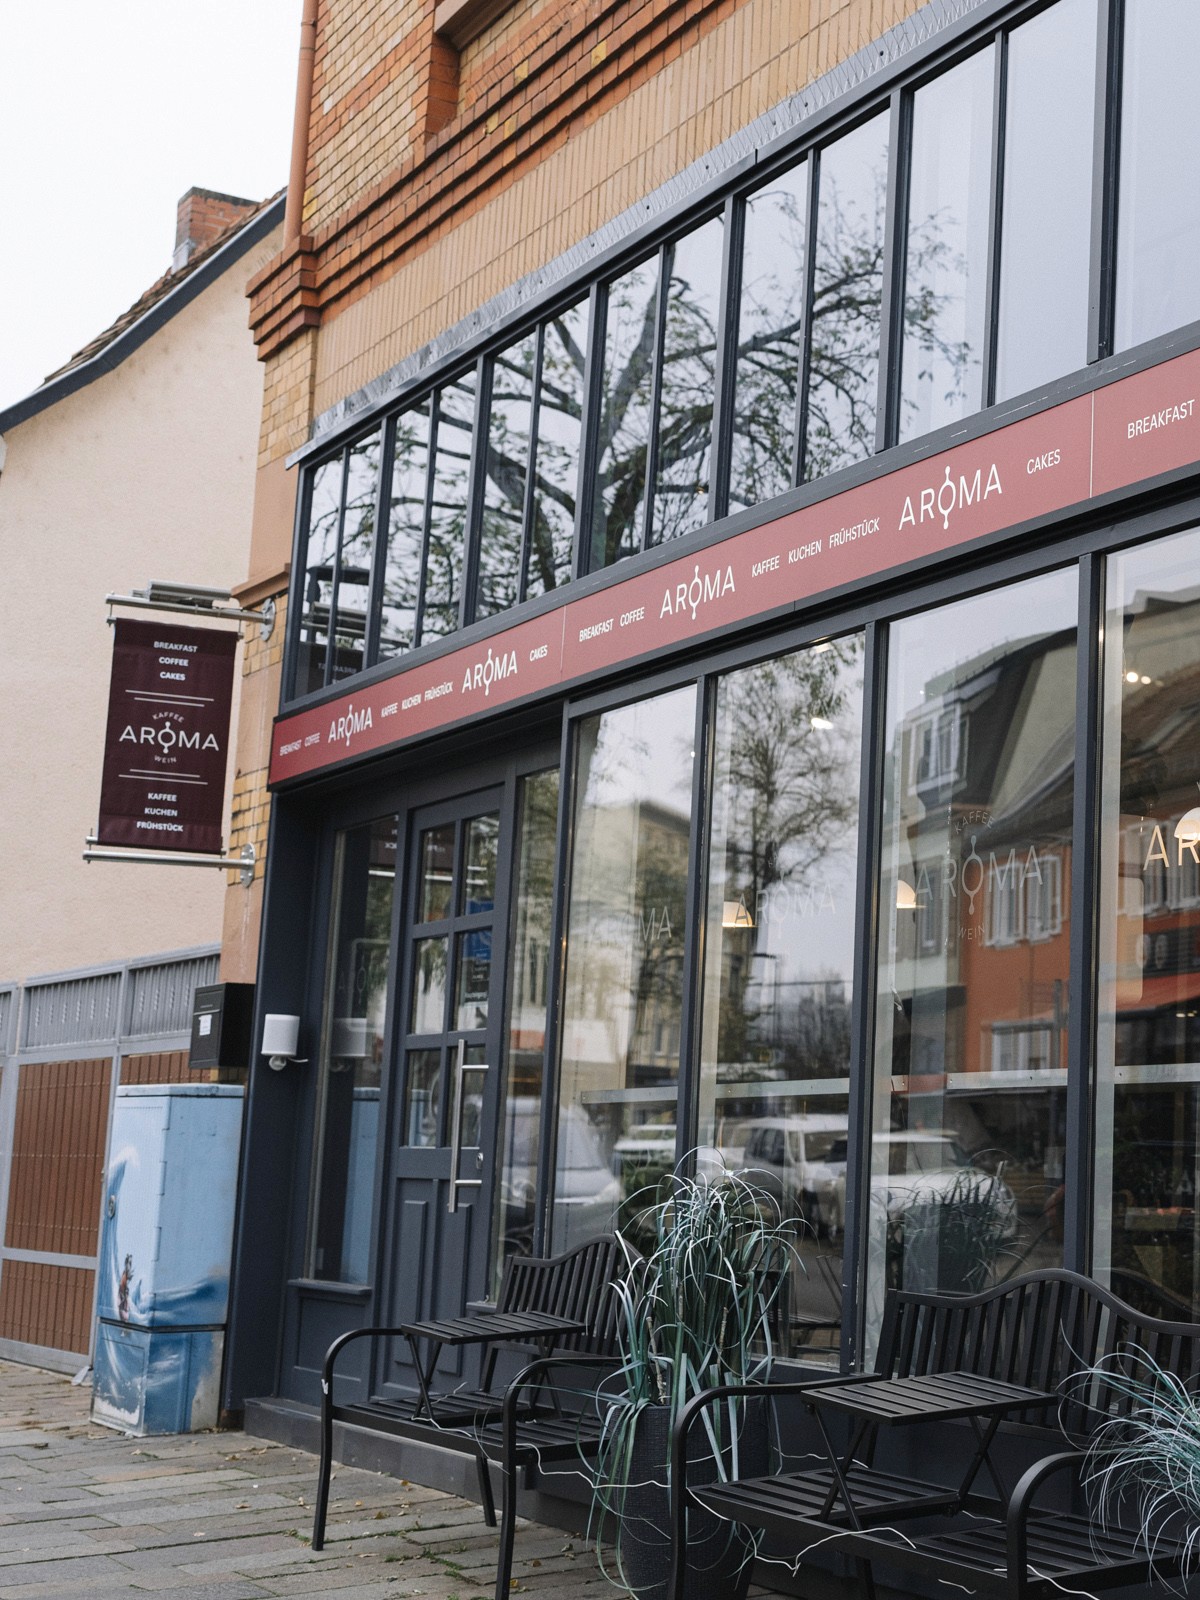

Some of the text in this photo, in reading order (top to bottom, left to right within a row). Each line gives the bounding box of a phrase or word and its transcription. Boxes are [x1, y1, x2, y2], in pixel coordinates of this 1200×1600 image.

[1127, 399, 1195, 439] BREAKFAST
[579, 449, 1061, 642] BREAKFAST COFFEE AROMA KAFFEE KUCHEN FRÜHSTÜCK AROMA CAKES
[153, 641, 198, 653] BREAKFAST
[158, 656, 189, 667] COFFEE
[160, 671, 186, 681] CAKES
[328, 704, 373, 747] AROMA
[402, 693, 421, 710] KUCHEN
[462, 648, 518, 696] AROMA
[530, 645, 548, 662] CAKES
[152, 711, 185, 723] KAFFEE
[119, 721, 219, 754] AROMA
[154, 755, 177, 764] WEIN
[148, 792, 177, 802] KAFFEE
[144, 807, 178, 817] KUCHEN
[136, 821, 183, 832] FRÜHSTÜCK
[954, 810, 995, 835] KAFFEE
[915, 835, 1043, 916] AROMA
[734, 870, 836, 939] AROMA
[958, 923, 985, 940] WEIN
